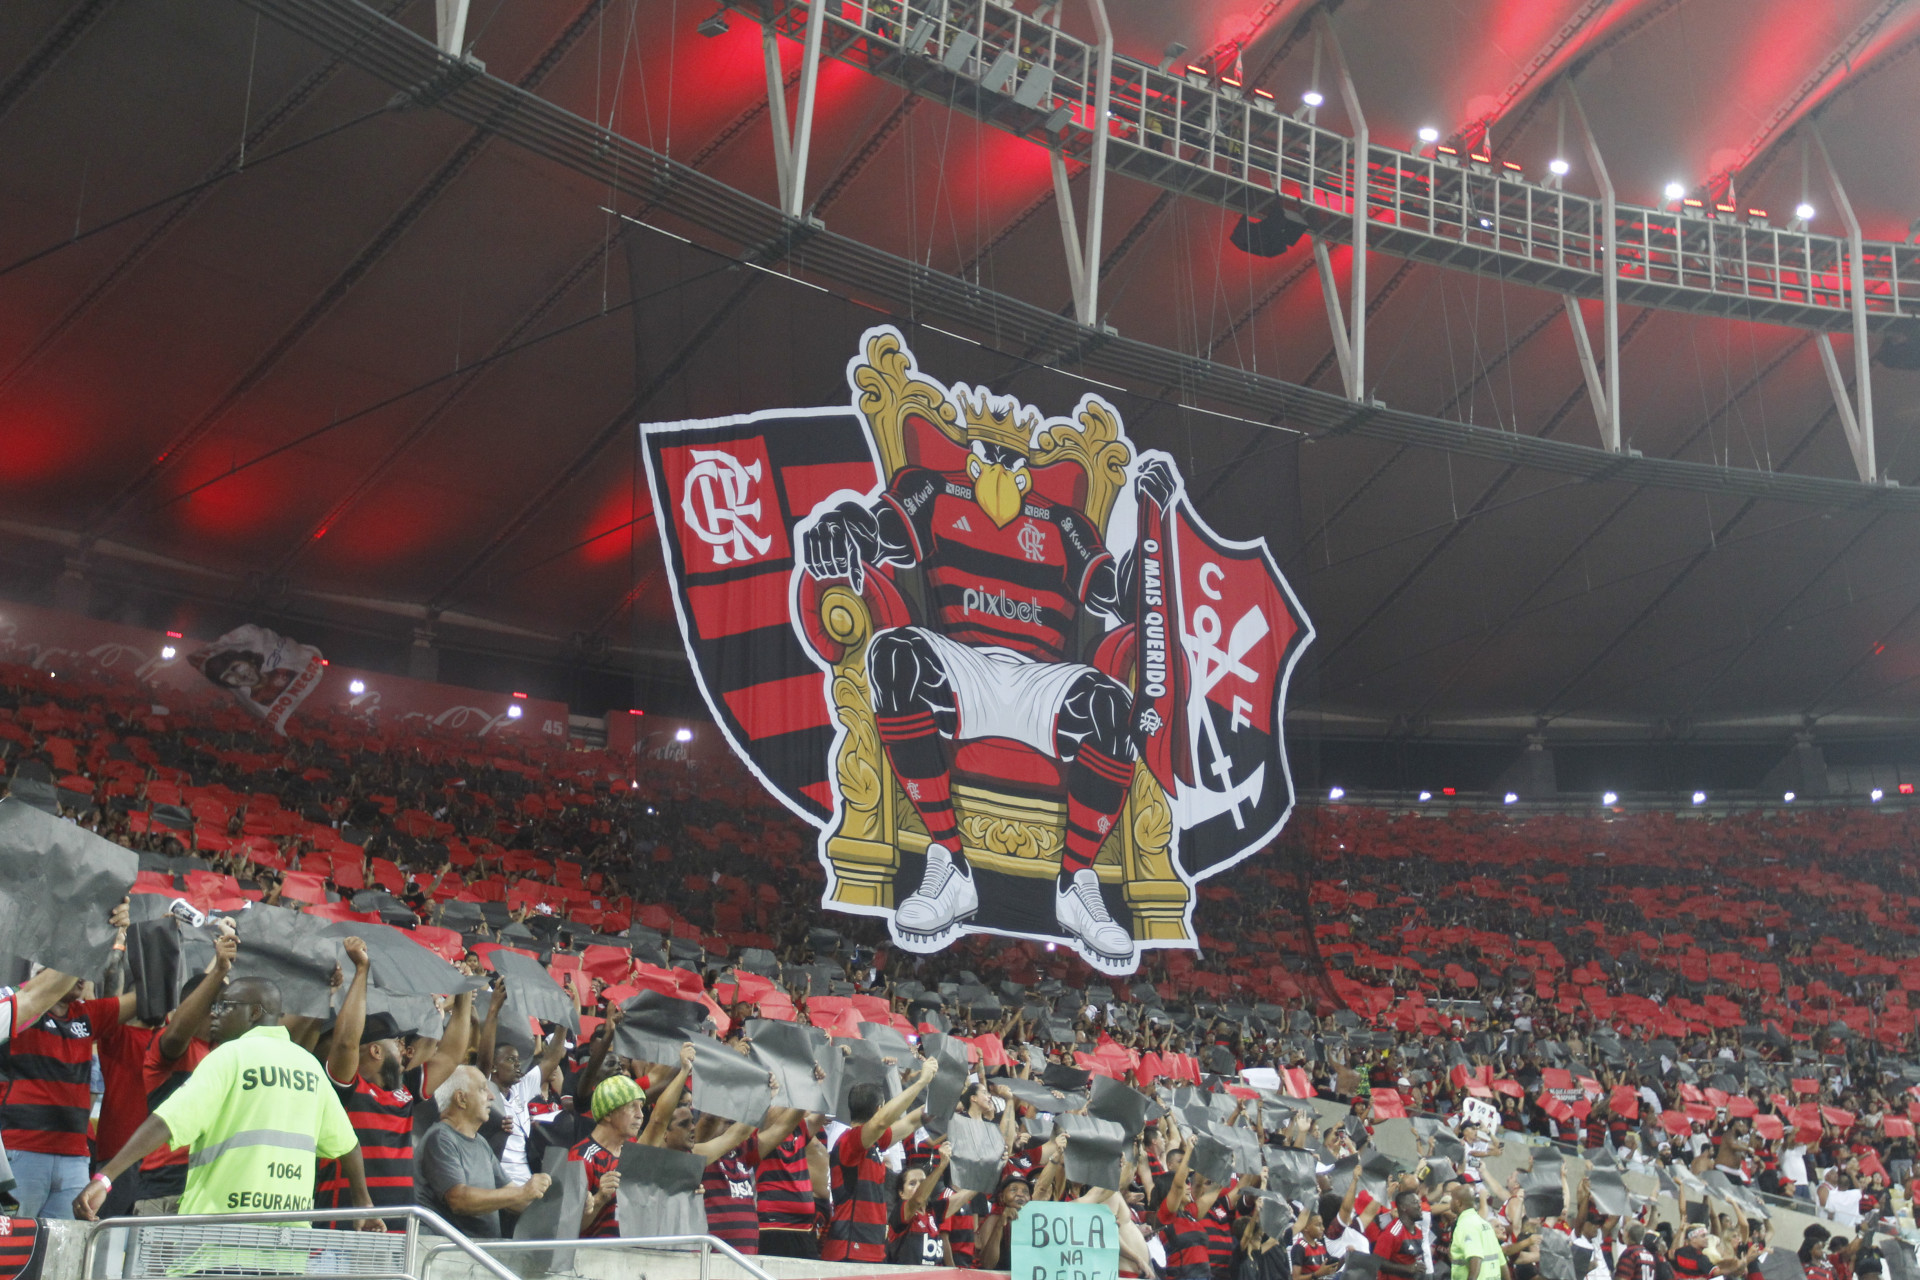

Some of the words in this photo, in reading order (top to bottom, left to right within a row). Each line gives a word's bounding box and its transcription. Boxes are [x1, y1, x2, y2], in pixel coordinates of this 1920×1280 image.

[912, 480, 935, 507] Kwai
[955, 485, 972, 499] BRB
[1033, 507, 1050, 520] BRB
[1069, 530, 1091, 560] Kwai
[1143, 539, 1159, 553] O
[1144, 558, 1162, 606] MAIS
[1199, 562, 1225, 600] C
[963, 585, 1042, 627] pixbet
[1144, 612, 1166, 697] QUERIDO
[542, 719, 563, 735] 45
[1231, 694, 1253, 733] F
[242, 1066, 319, 1093] SUNSET
[267, 1162, 302, 1180] 1064
[1031, 1213, 1106, 1248] BOLA
[1060, 1249, 1083, 1267] NA
